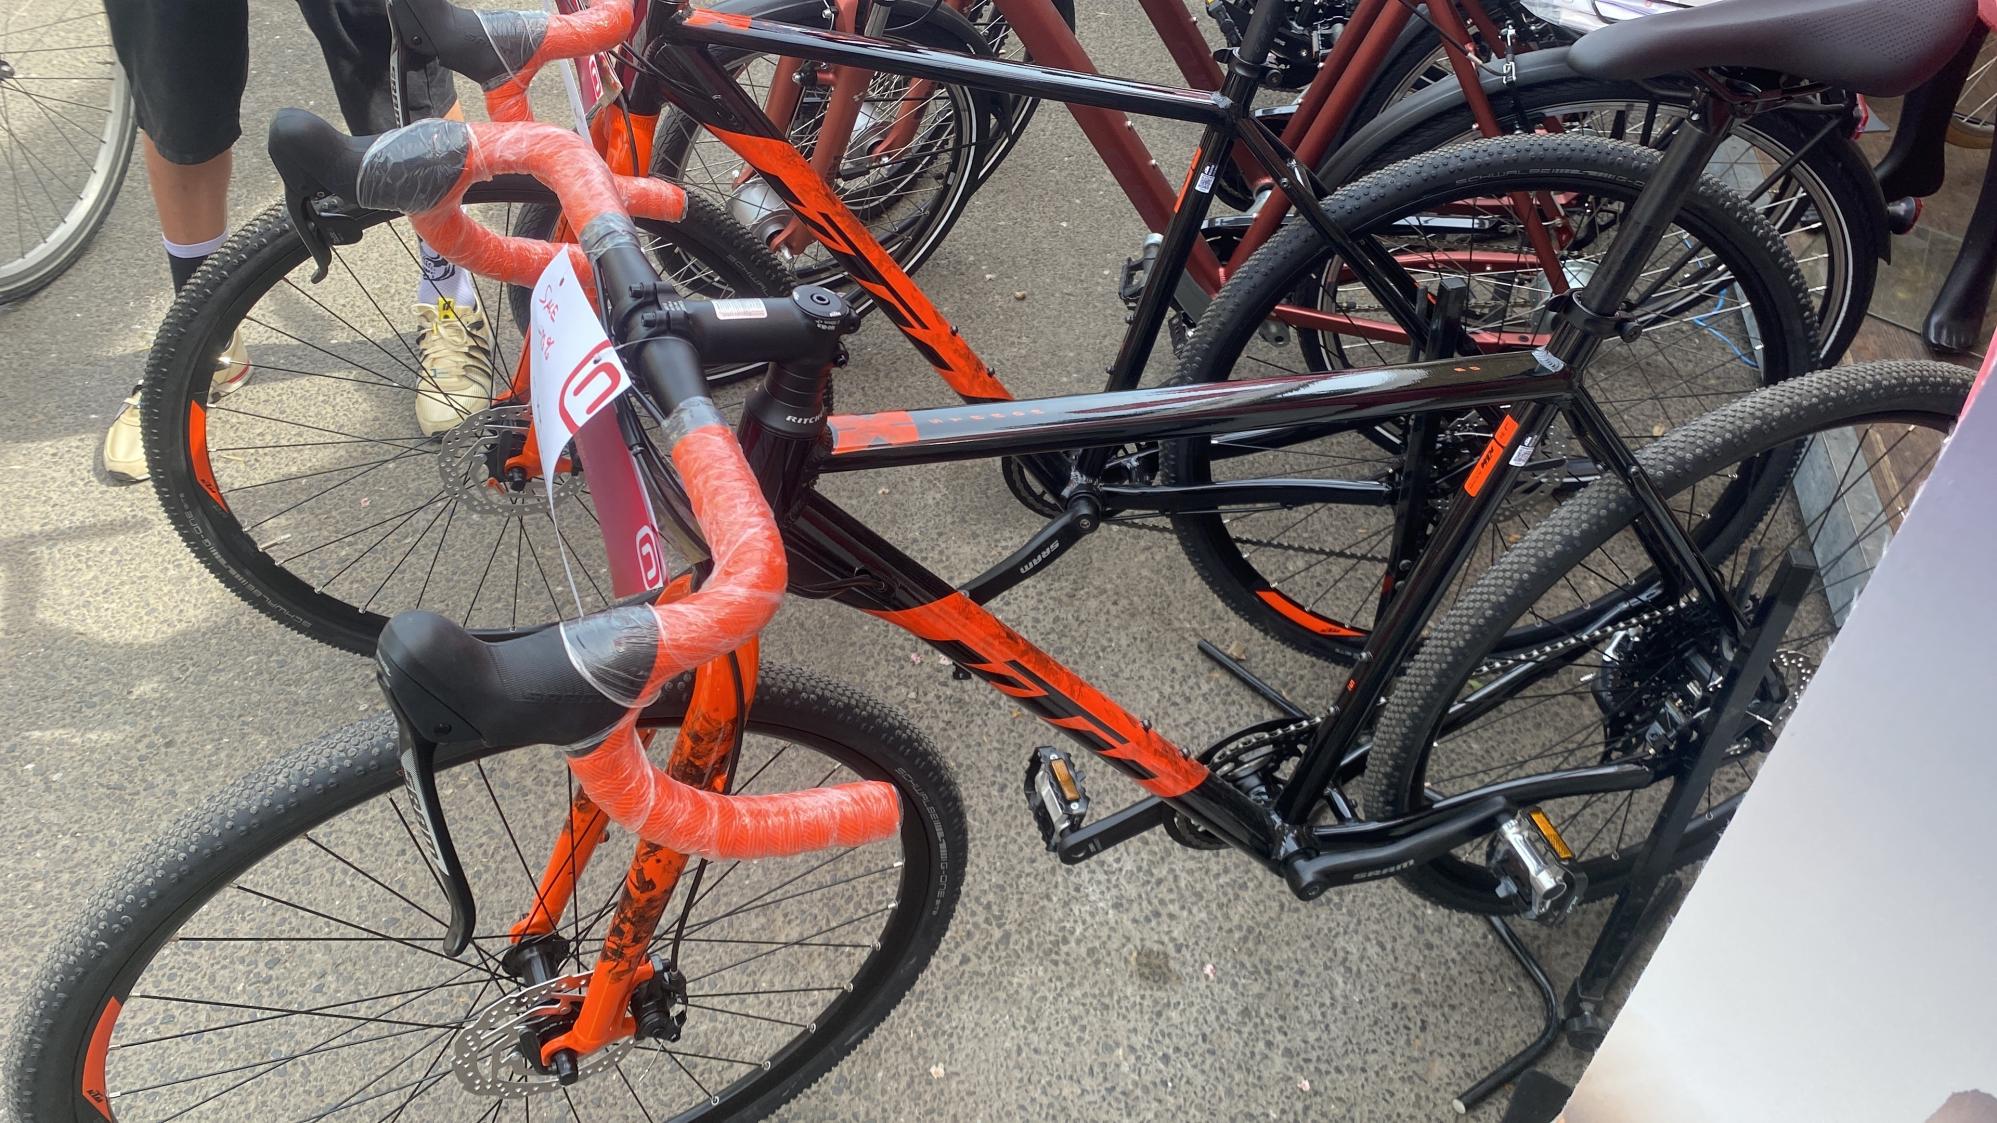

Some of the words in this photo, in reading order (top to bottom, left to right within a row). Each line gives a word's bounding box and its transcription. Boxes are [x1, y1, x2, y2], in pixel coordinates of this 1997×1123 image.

[1020, 540, 1060, 574] SRAM
[895, 766, 940, 821] SCHWALBE
[1352, 859, 1415, 881] SRAM
